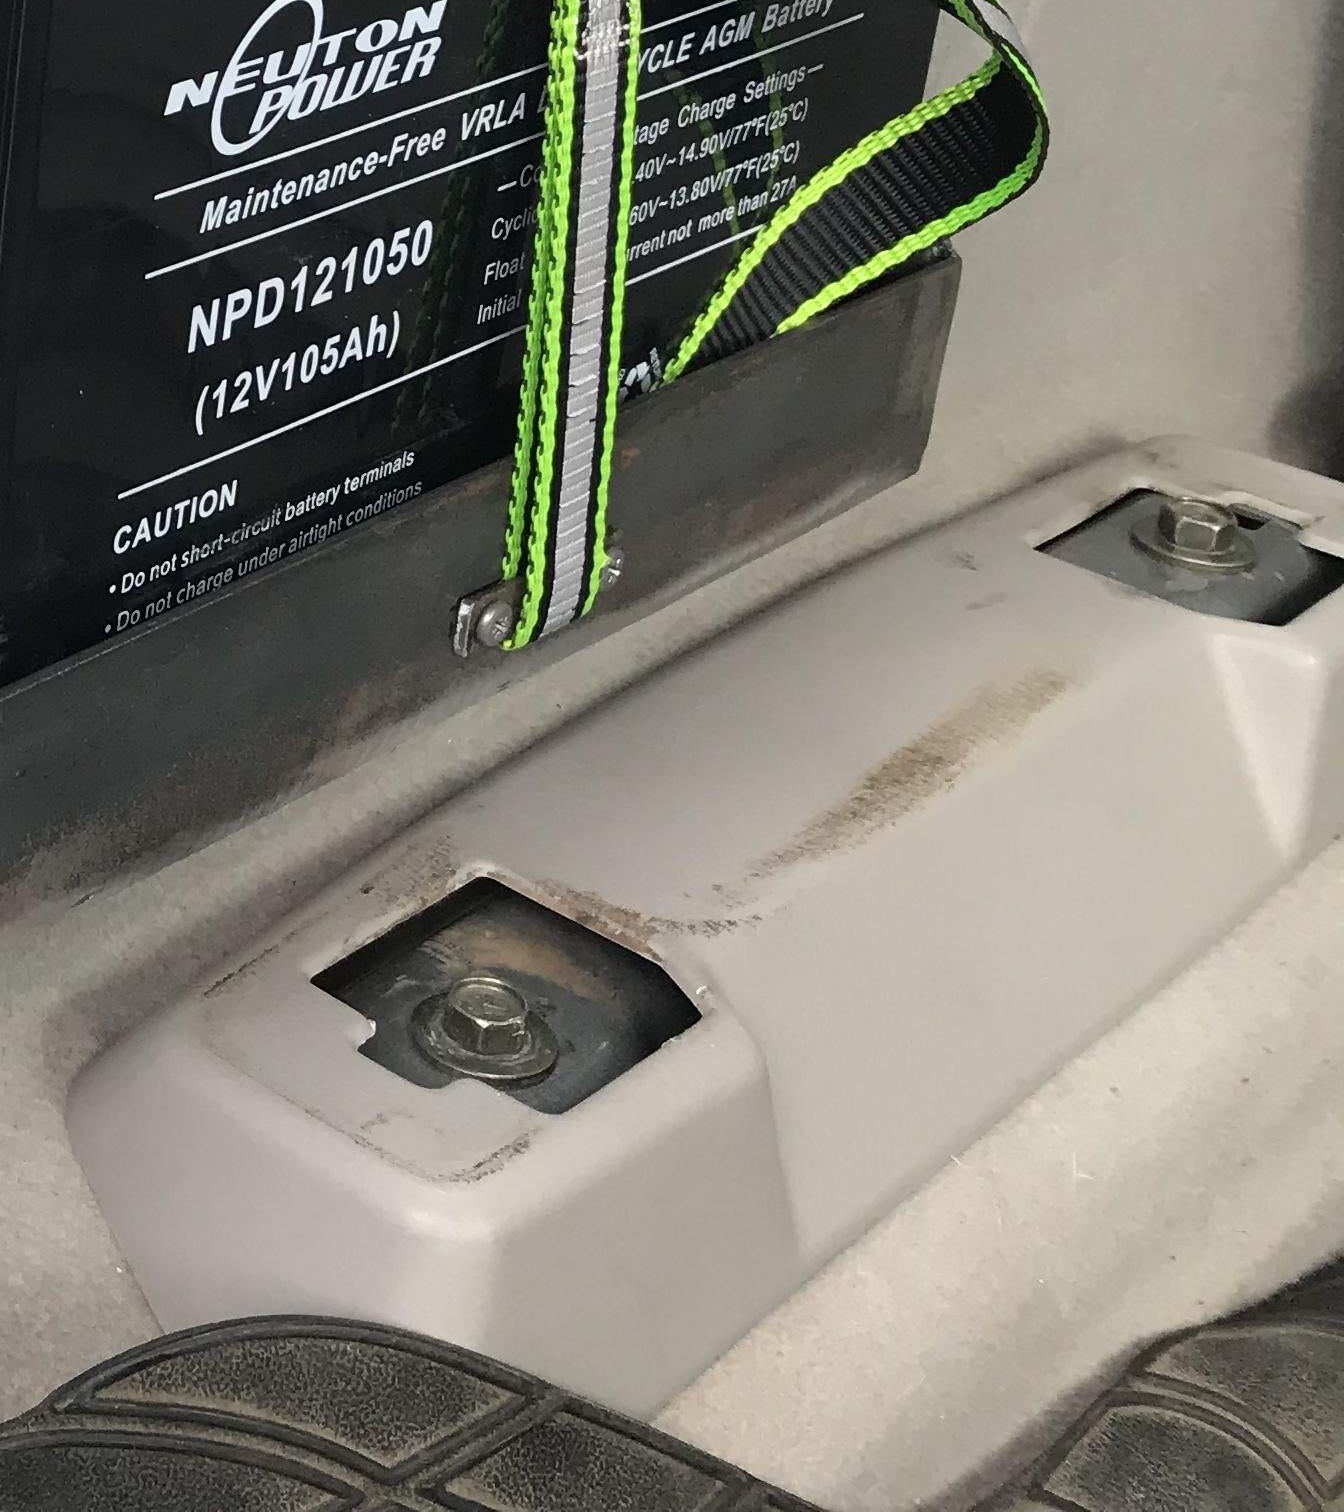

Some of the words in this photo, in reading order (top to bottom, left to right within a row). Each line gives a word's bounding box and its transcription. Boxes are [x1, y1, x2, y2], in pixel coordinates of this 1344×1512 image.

[200, 124, 448, 234] Maintenance-Free
[459, 91, 528, 141] VRLA
[699, 11, 756, 56] AGM
[248, 35, 443, 135] POWER
[677, 92, 736, 129] Charge
[483, 251, 526, 286] Float
[667, 219, 693, 247] not
[697, 206, 735, 234] more
[737, 190, 768, 217] than
[186, 220, 434, 354] NPD121050
[476, 288, 523, 325] Initial
[194, 310, 400, 436] (12V105Ah)
[112, 479, 239, 555] CAUTION
[116, 610, 141, 633] Do
[144, 594, 172, 621] not
[175, 569, 234, 609] charge
[237, 541, 286, 576] under
[288, 513, 343, 556] airtight
[345, 481, 423, 528] conditions
[121, 571, 146, 594] Do
[149, 556, 177, 583] not
[180, 507, 281, 569] short-circuit
[284, 486, 341, 523] battery
[344, 450, 415, 493] terminals
